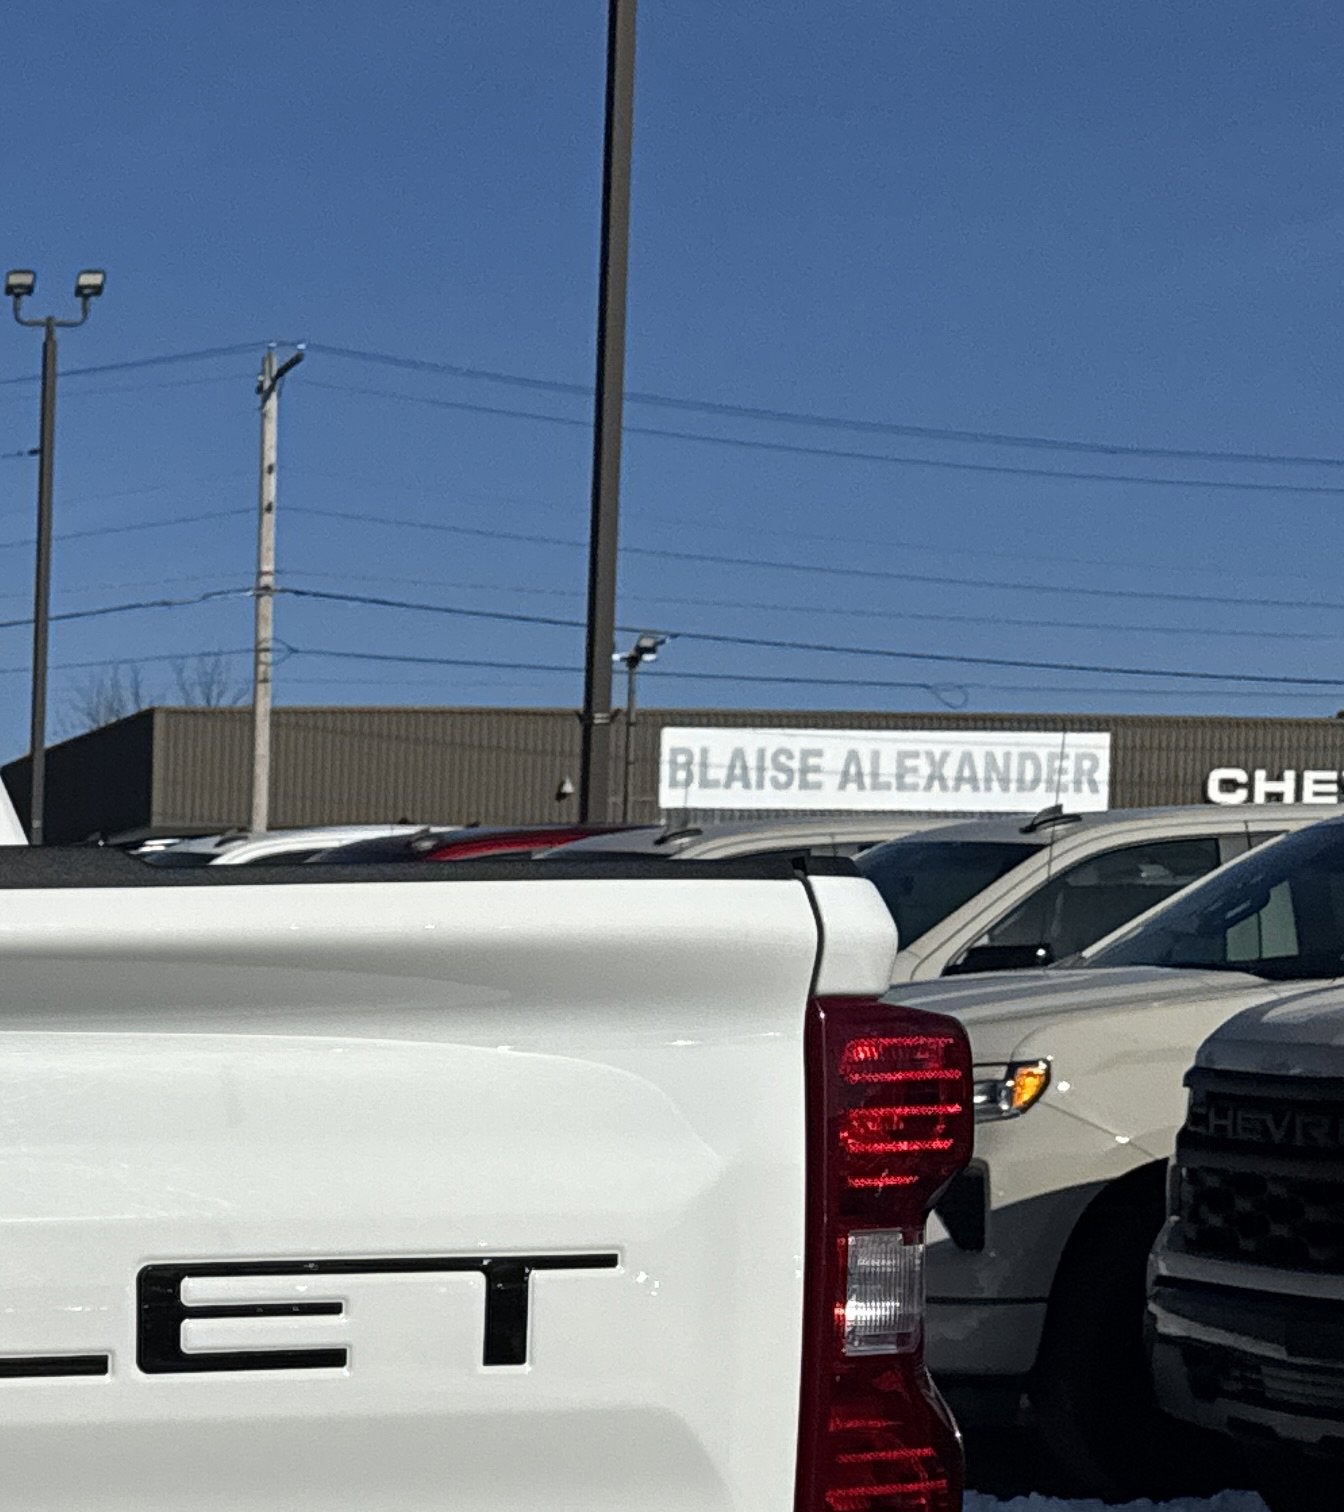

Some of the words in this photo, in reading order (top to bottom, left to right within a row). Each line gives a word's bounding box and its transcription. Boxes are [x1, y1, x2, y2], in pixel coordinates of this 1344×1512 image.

[666, 746, 824, 791] BLAISE
[837, 749, 1101, 794] ALEXANDER
[1207, 767, 1344, 805] CHE
